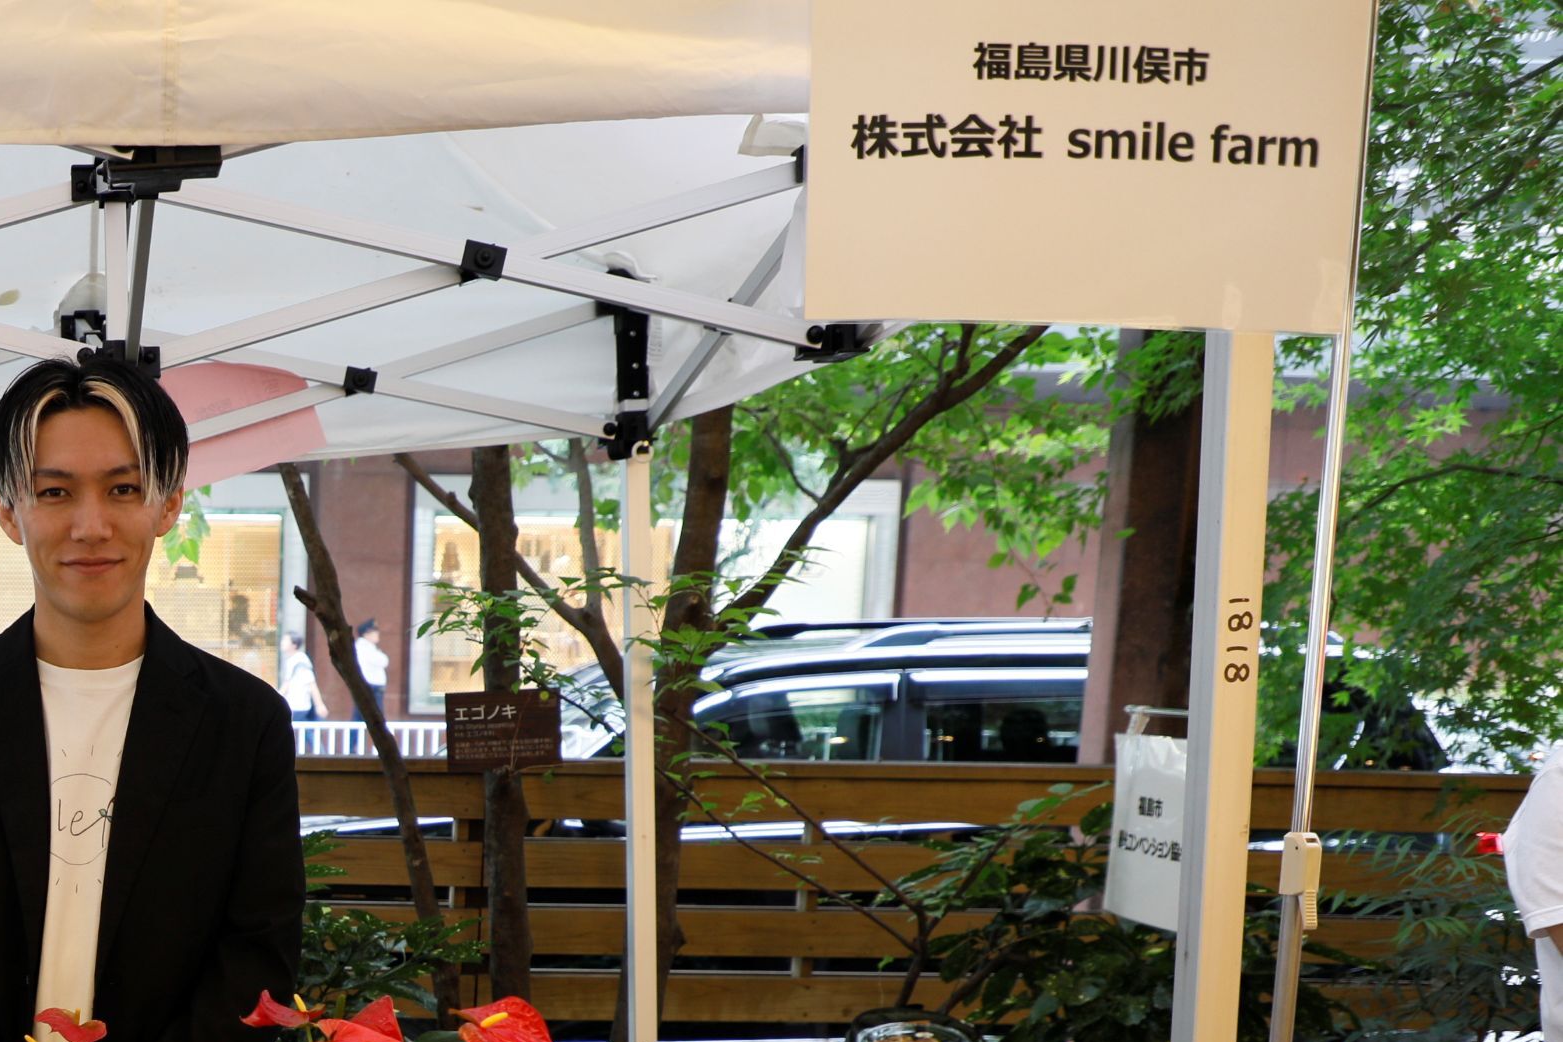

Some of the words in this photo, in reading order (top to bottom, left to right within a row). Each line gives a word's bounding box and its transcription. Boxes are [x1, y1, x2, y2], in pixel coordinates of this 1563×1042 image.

[972, 41, 1210, 86] 福島県川俣市
[850, 113, 1043, 160] 株式会社
[1067, 120, 1195, 163] smile
[1210, 123, 1319, 168] farm
[1224, 596, 1254, 684] 1818
[454, 704, 517, 720] エゴノキ
